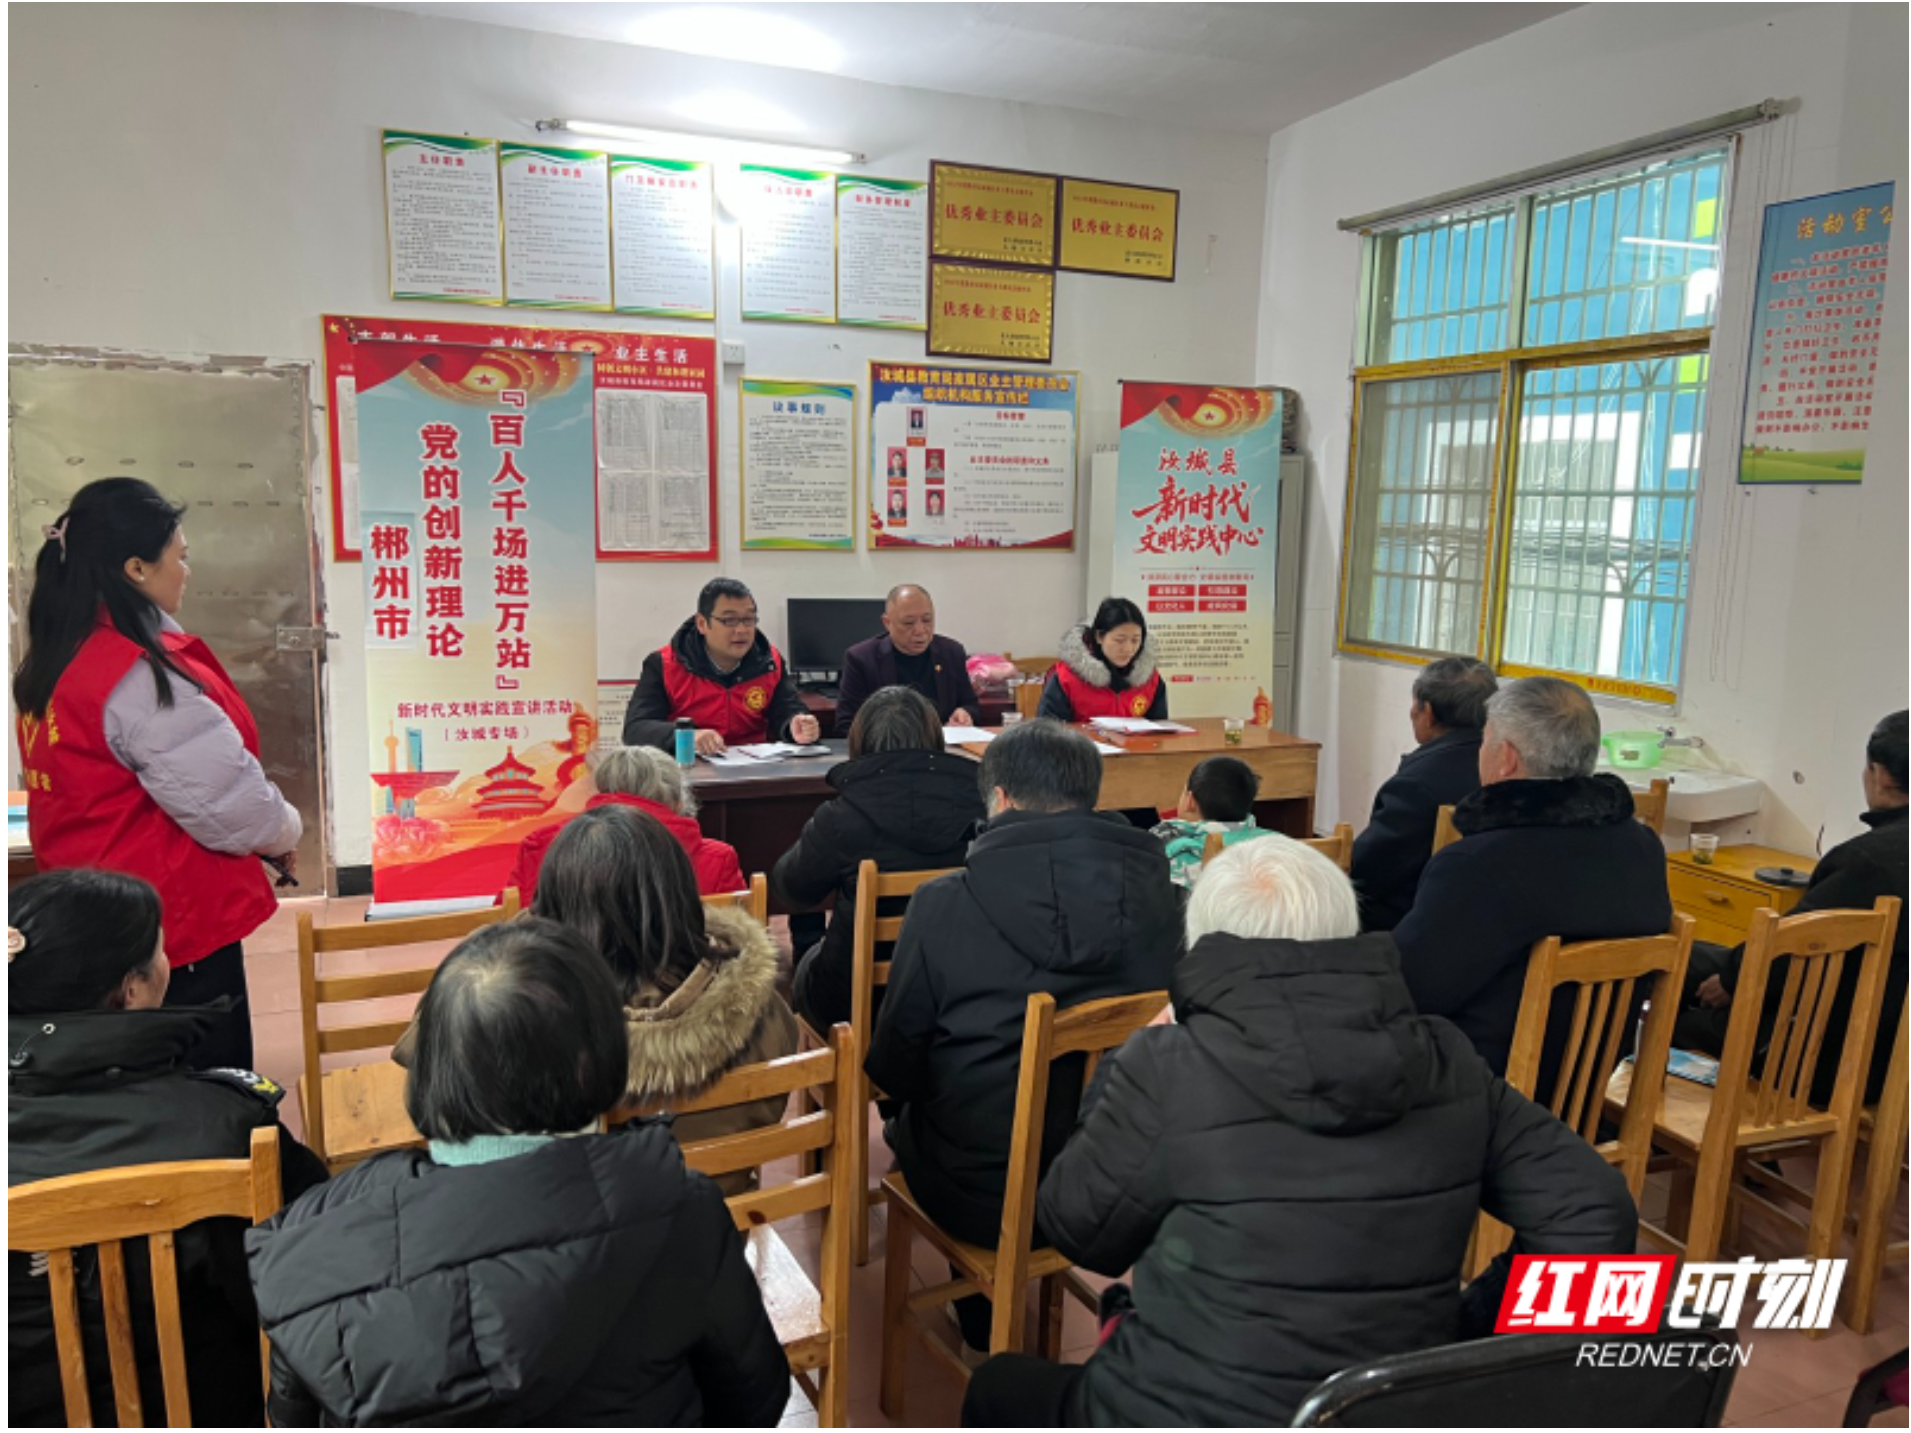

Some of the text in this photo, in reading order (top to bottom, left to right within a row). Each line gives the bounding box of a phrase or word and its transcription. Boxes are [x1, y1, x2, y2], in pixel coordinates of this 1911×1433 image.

[945, 203, 1043, 229] 优秀业主委员会
[1072, 217, 1164, 243] 优秀业主委员会
[943, 300, 1041, 324] 优秀业主委员会
[615, 345, 688, 364] 业主生活
[1157, 447, 1238, 476] 汝城县
[1132, 475, 1251, 525] 新时代
[420, 423, 465, 659] 党的创新理论
[489, 389, 532, 691] 『百人千场进万站』
[1133, 522, 1265, 556] 文明实践中心
[370, 524, 412, 641] 郴州市
[397, 699, 574, 719] 新时代文明实践宣讲活动
